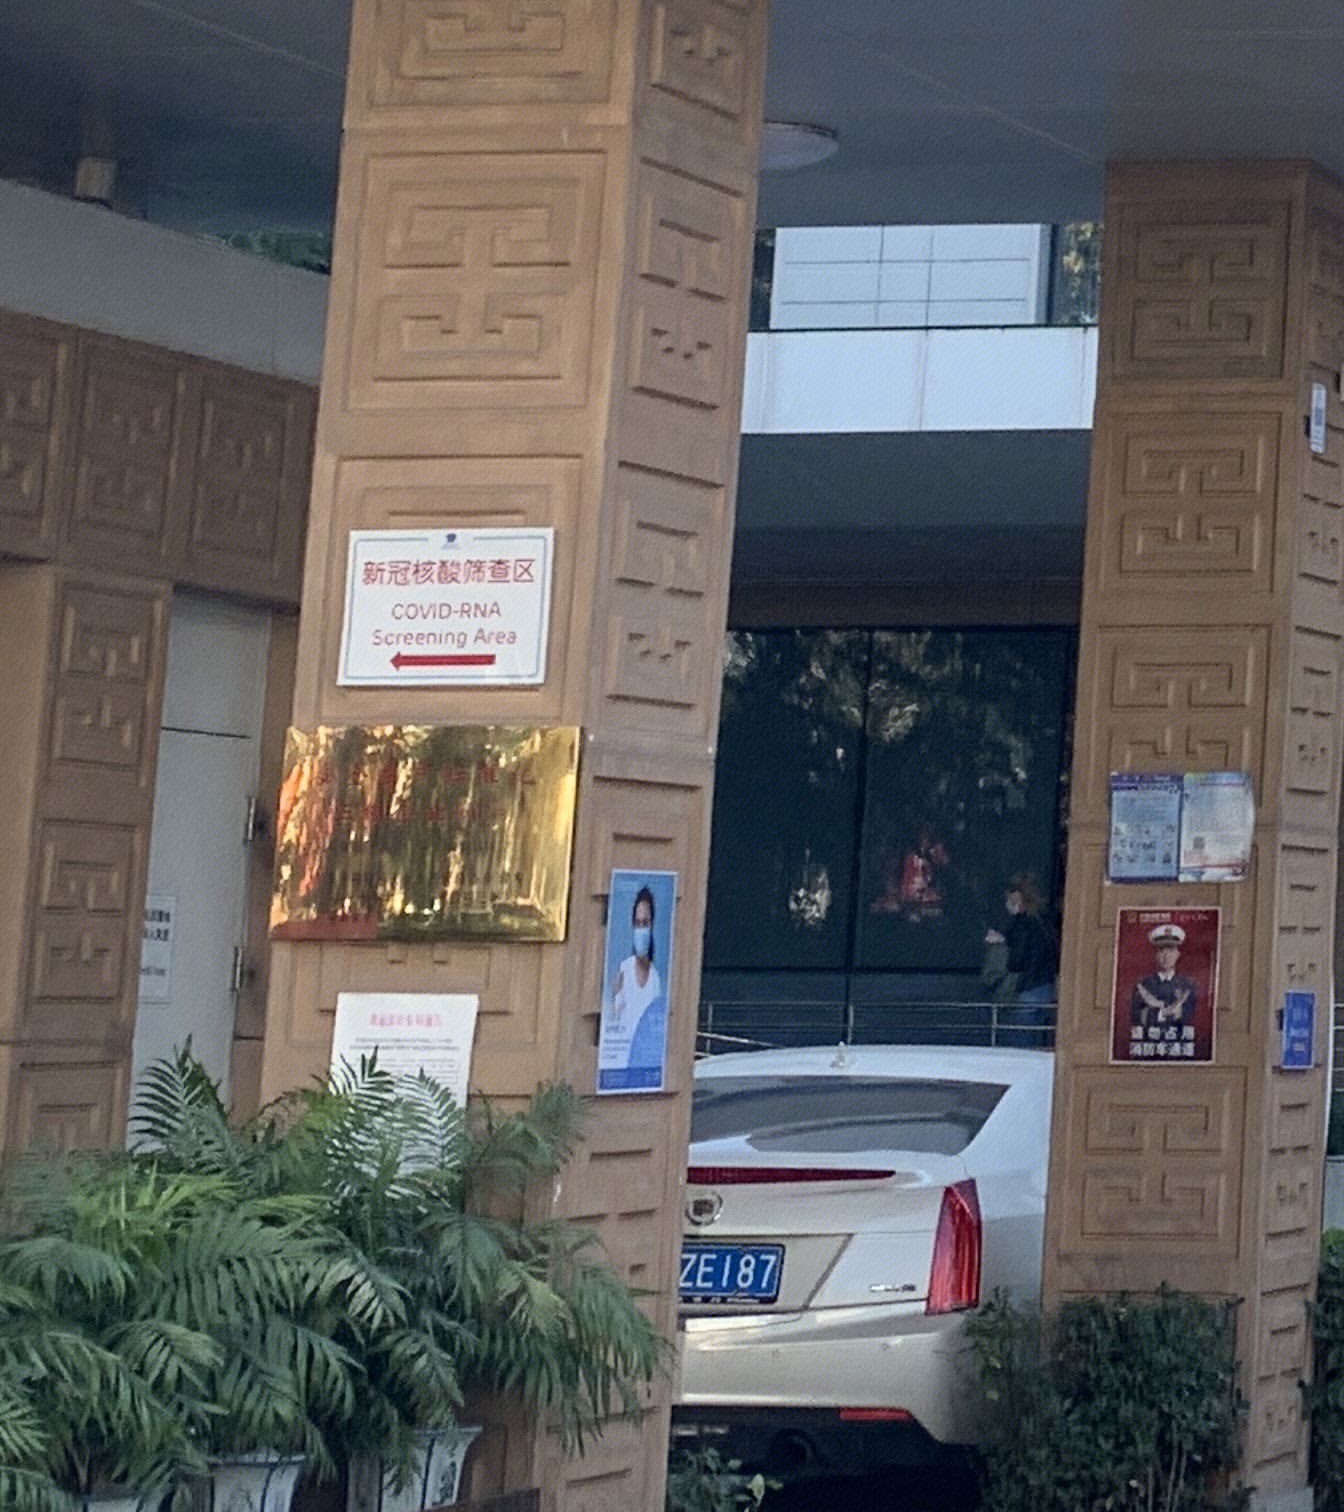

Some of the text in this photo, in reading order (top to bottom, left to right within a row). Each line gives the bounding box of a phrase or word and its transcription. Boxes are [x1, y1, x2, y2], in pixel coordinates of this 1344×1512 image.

[363, 558, 536, 586] 新冠核酸筛查区
[391, 600, 502, 621] COVID-RNA
[372, 627, 517, 649] Screening Area
[679, 1253, 777, 1288] ZE187
